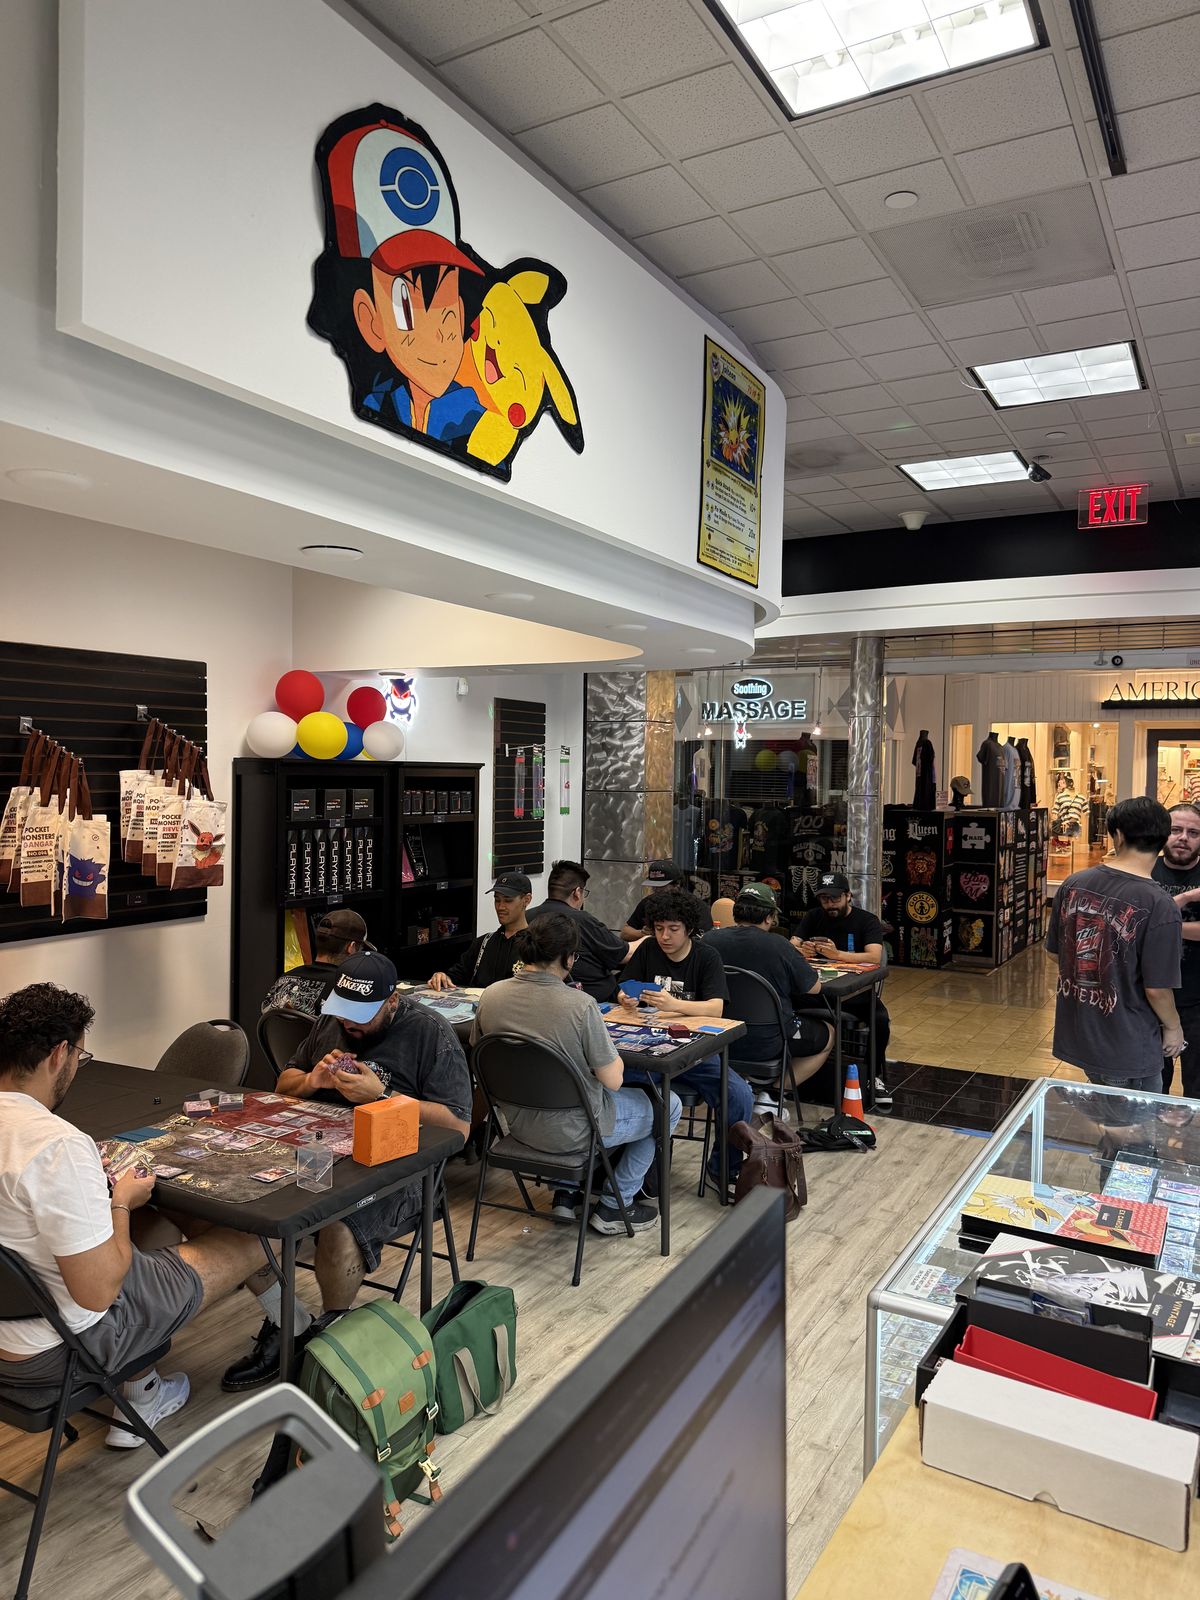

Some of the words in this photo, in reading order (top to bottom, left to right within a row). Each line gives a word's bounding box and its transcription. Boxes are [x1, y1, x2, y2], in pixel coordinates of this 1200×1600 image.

[1088, 487, 1141, 524] EXIT
[733, 683, 767, 696] Soothing
[701, 700, 807, 720] MASSAGE
[907, 822, 938, 841] Queen
[289, 843, 297, 896] PLAYMAT
[331, 840, 339, 892] PLAYMAT
[337, 973, 374, 996] LAKERS
[1165, 1300, 1183, 1328] VINTAGE
